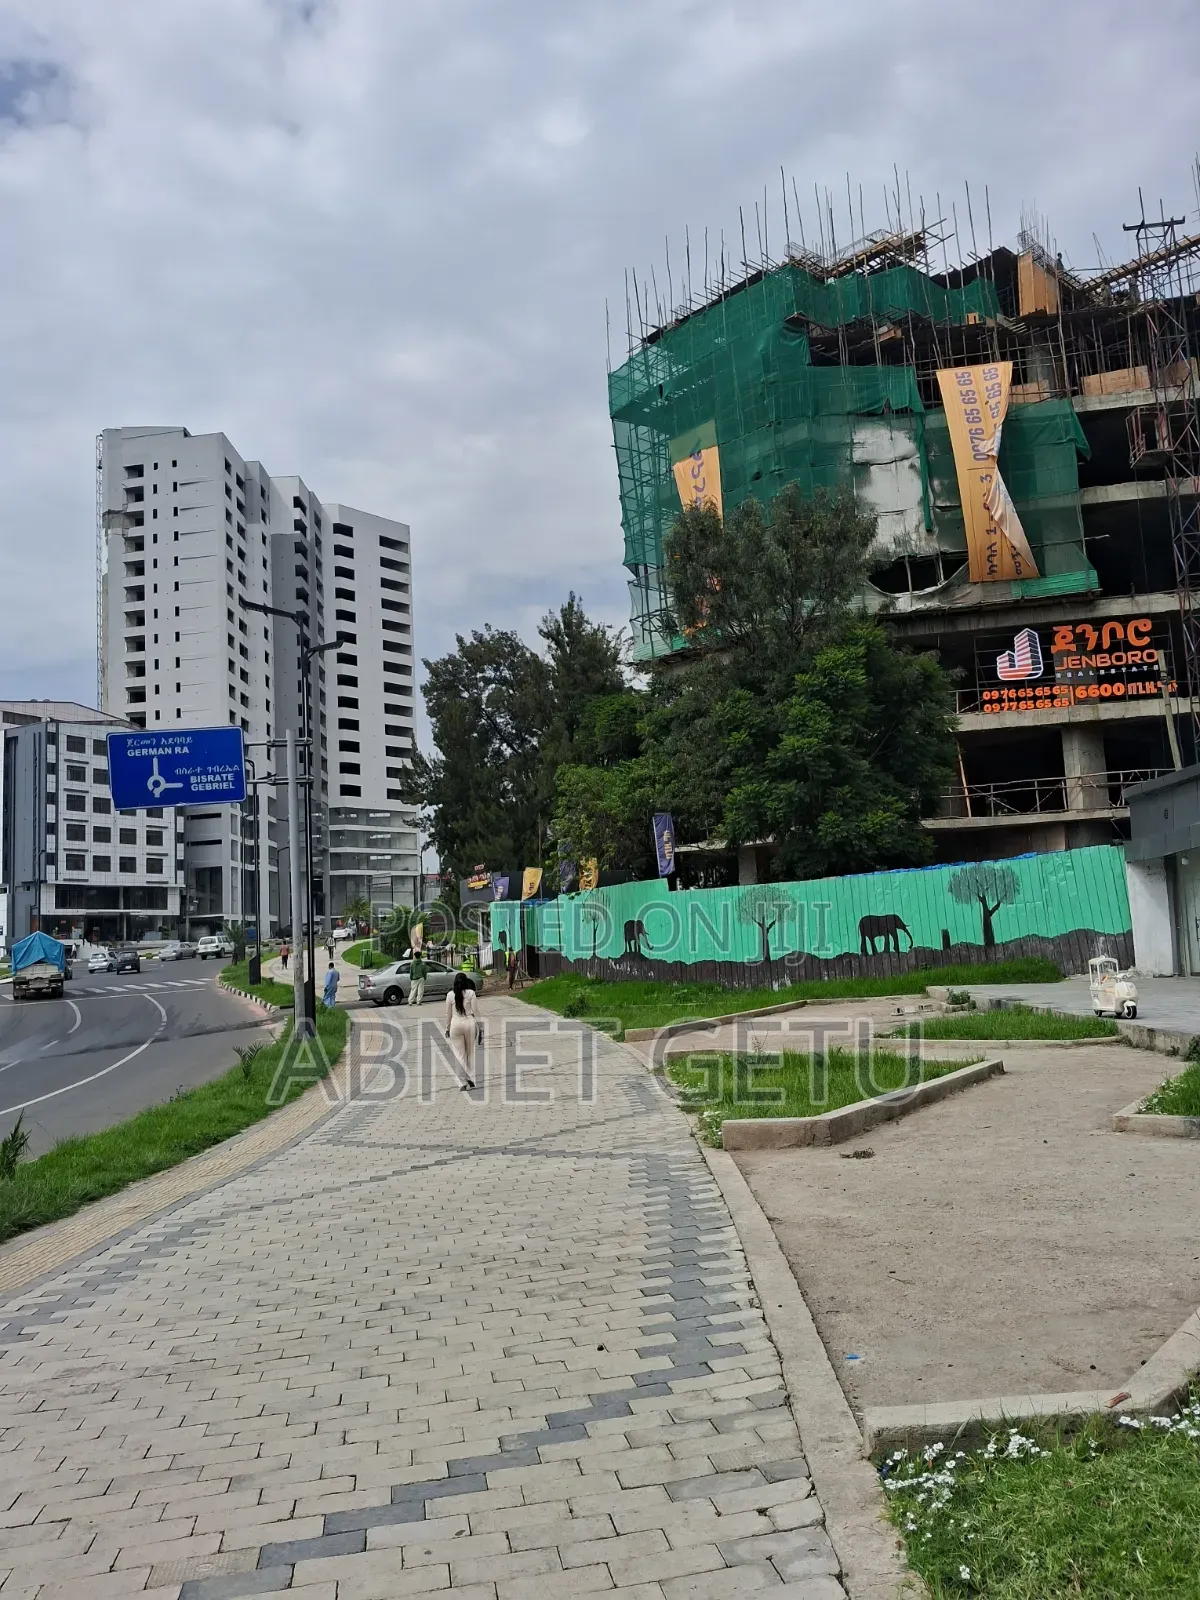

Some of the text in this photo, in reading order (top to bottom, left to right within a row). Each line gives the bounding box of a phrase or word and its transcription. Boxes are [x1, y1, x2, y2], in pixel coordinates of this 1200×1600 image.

[955, 371, 973, 386] 65
[983, 367, 999, 381] 65
[959, 389, 977, 405] 65
[985, 382, 1002, 399] 65
[964, 408, 982, 424] 65
[980, 473, 993, 483] 3
[1055, 648, 1158, 670] JENBORO
[1075, 682, 1125, 699] 6600
[127, 746, 190, 757] GERMAN RA
[190, 773, 235, 783] BISRATE
[191, 782, 236, 791] GEBRIEL
